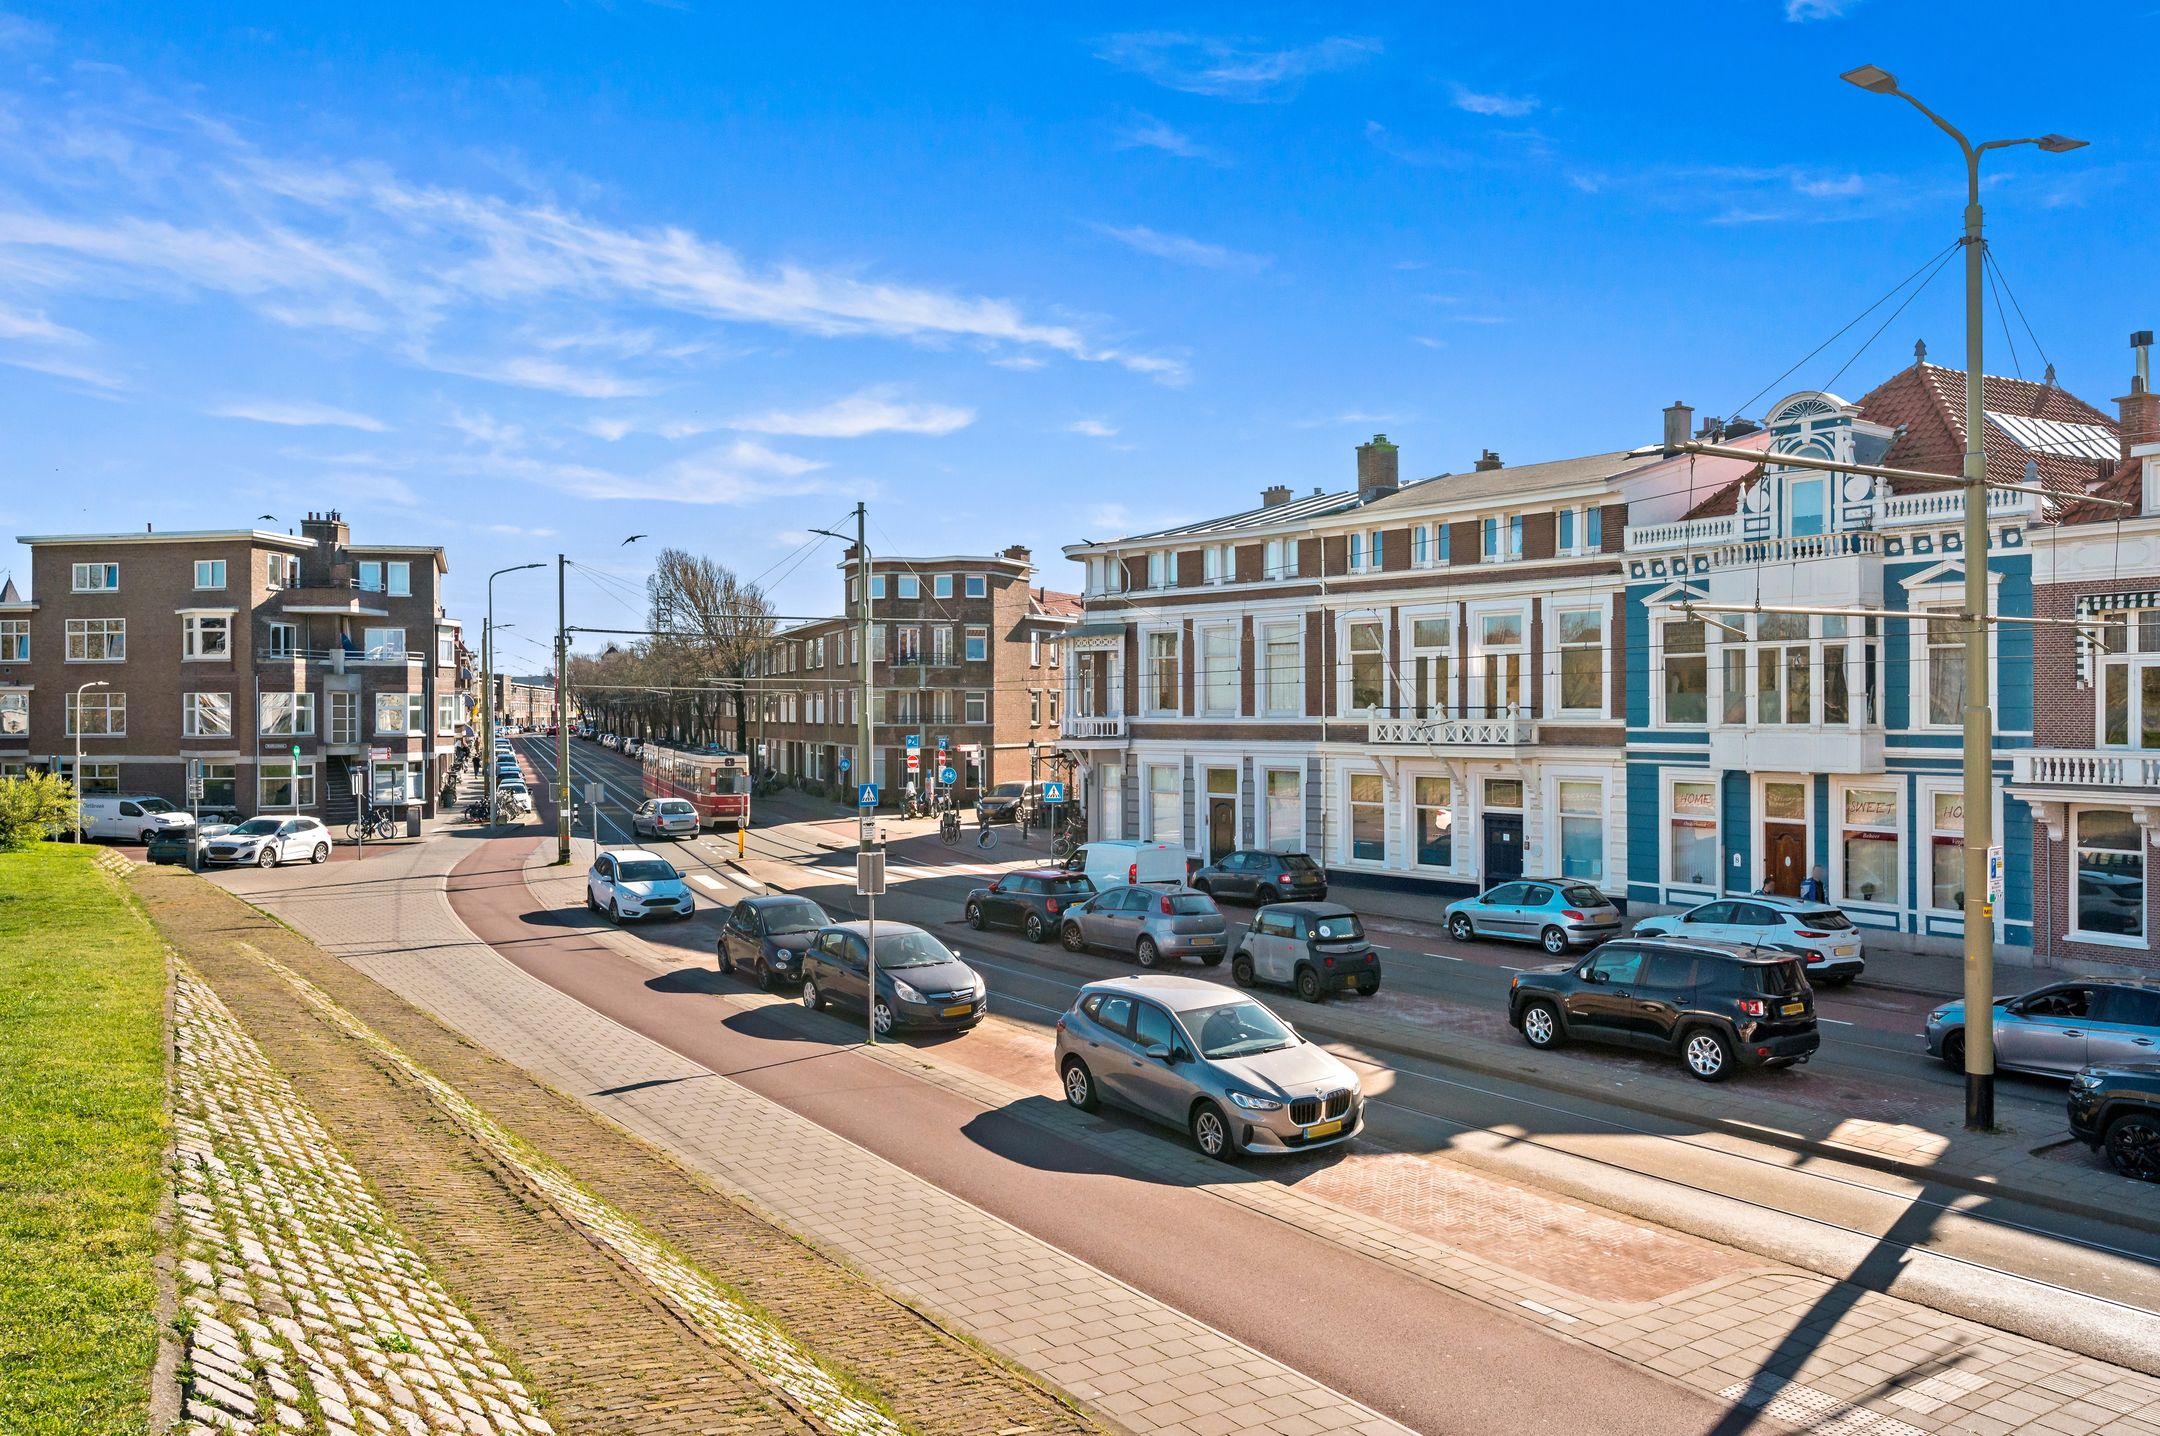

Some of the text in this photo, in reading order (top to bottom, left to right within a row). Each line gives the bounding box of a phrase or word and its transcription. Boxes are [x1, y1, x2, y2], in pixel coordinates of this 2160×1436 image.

[1680, 793, 1711, 804] HOME
[1849, 800, 1894, 814] SWEET
[1943, 805, 1965, 819] HO
